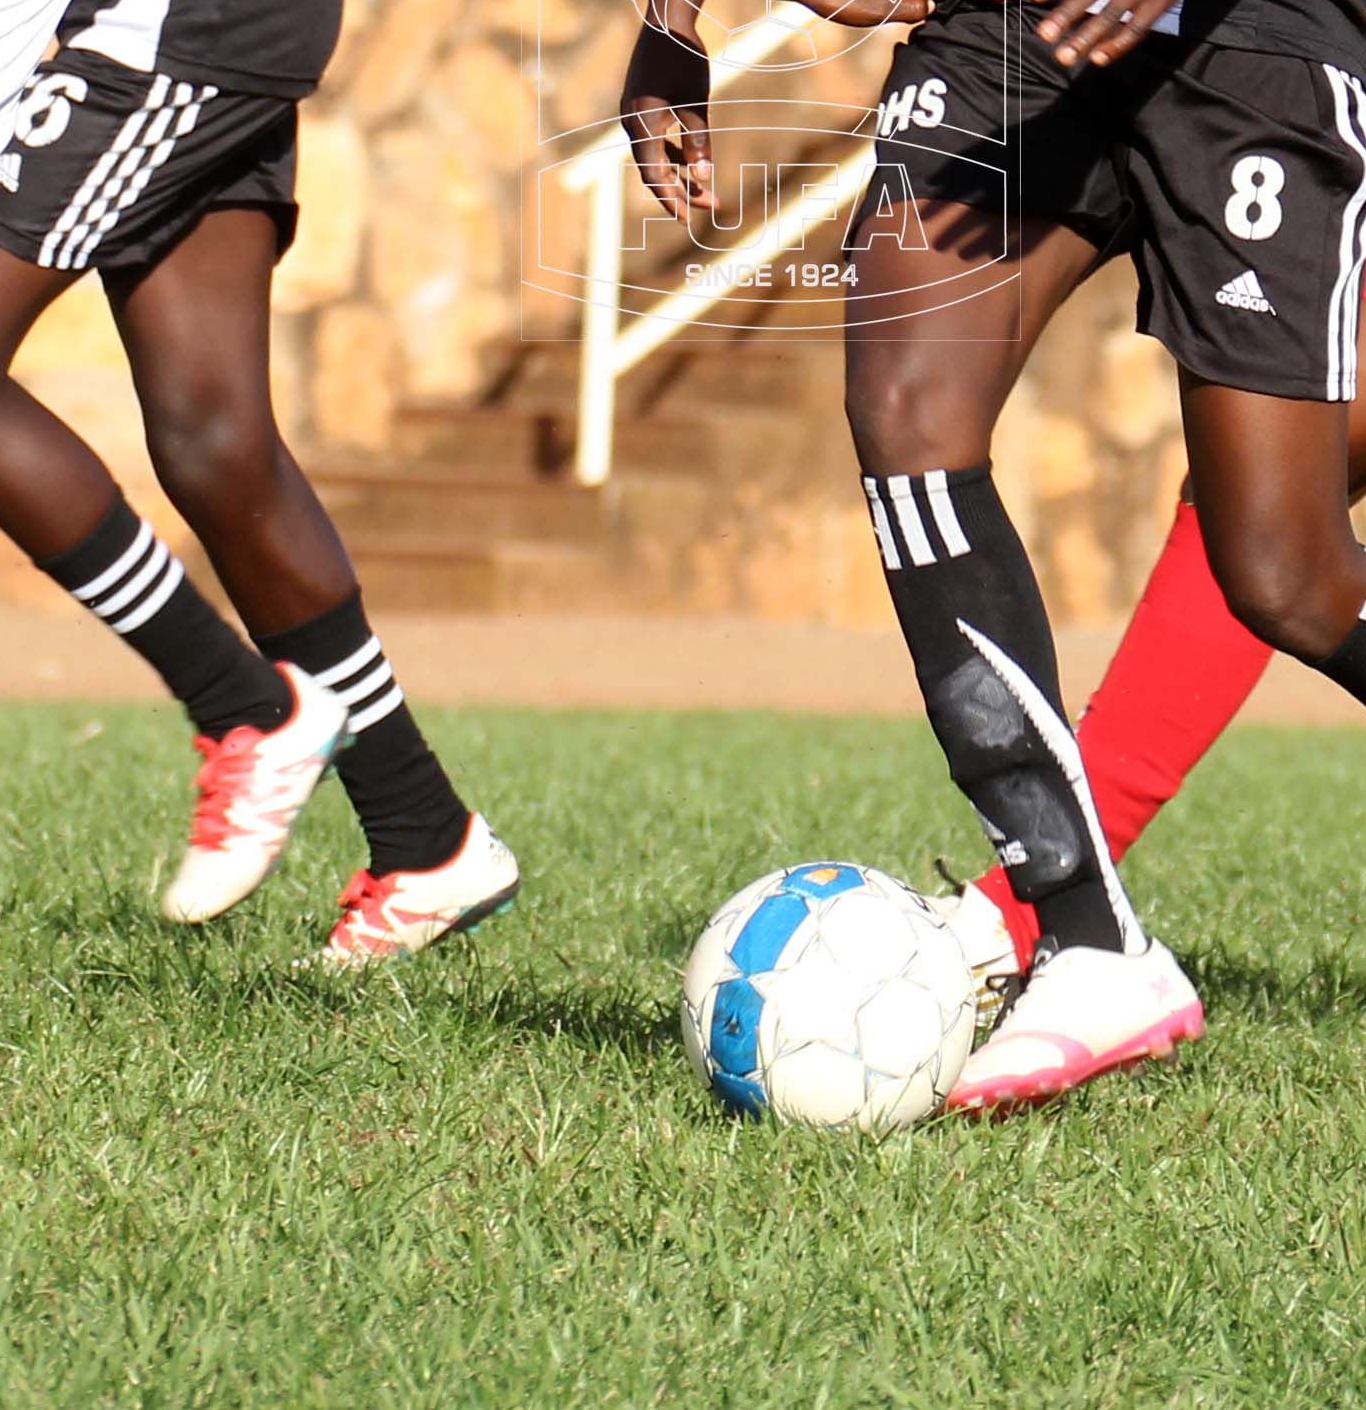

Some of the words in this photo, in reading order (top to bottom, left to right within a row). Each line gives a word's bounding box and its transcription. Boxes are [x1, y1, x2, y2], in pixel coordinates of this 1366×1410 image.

[876, 78, 947, 137] HS
[1225, 156, 1285, 241] 8
[1215, 290, 1269, 313] adidas
